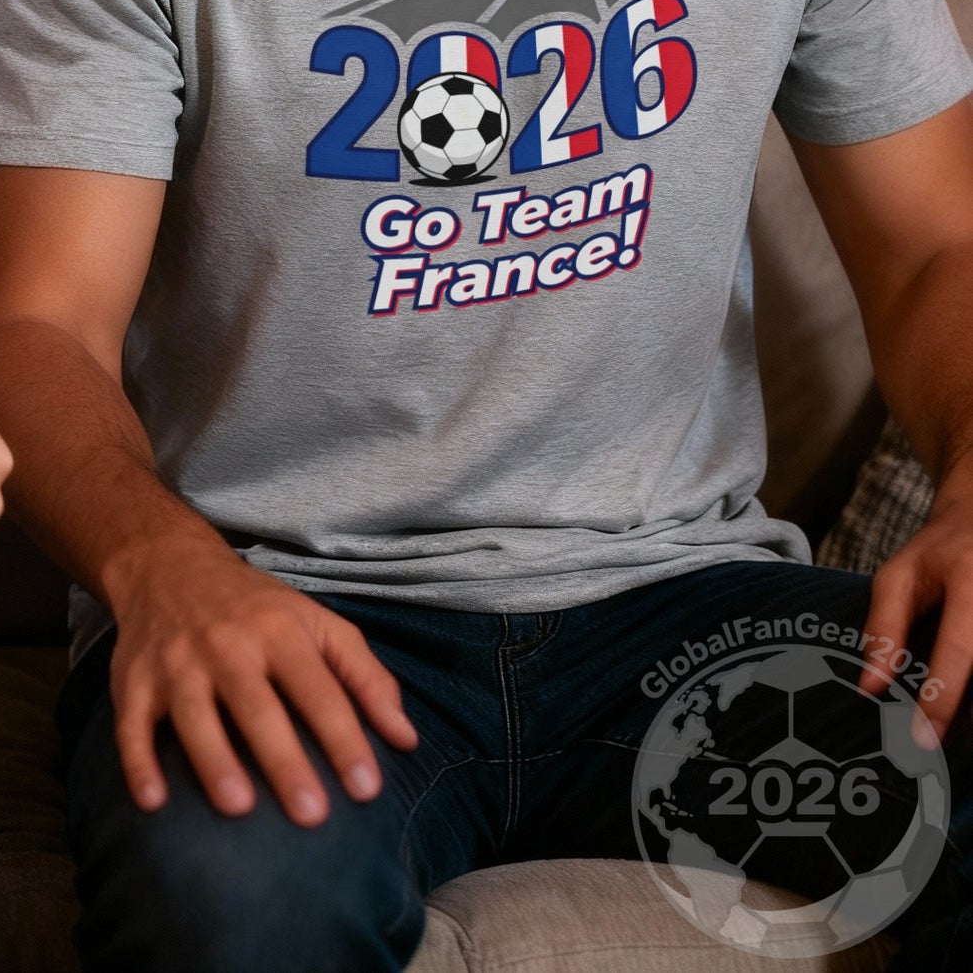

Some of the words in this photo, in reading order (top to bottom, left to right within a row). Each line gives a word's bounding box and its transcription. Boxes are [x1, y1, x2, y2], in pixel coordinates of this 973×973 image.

[360, 194, 462, 255] Go
[472, 162, 654, 246] Team
[367, 201, 651, 317] France!
